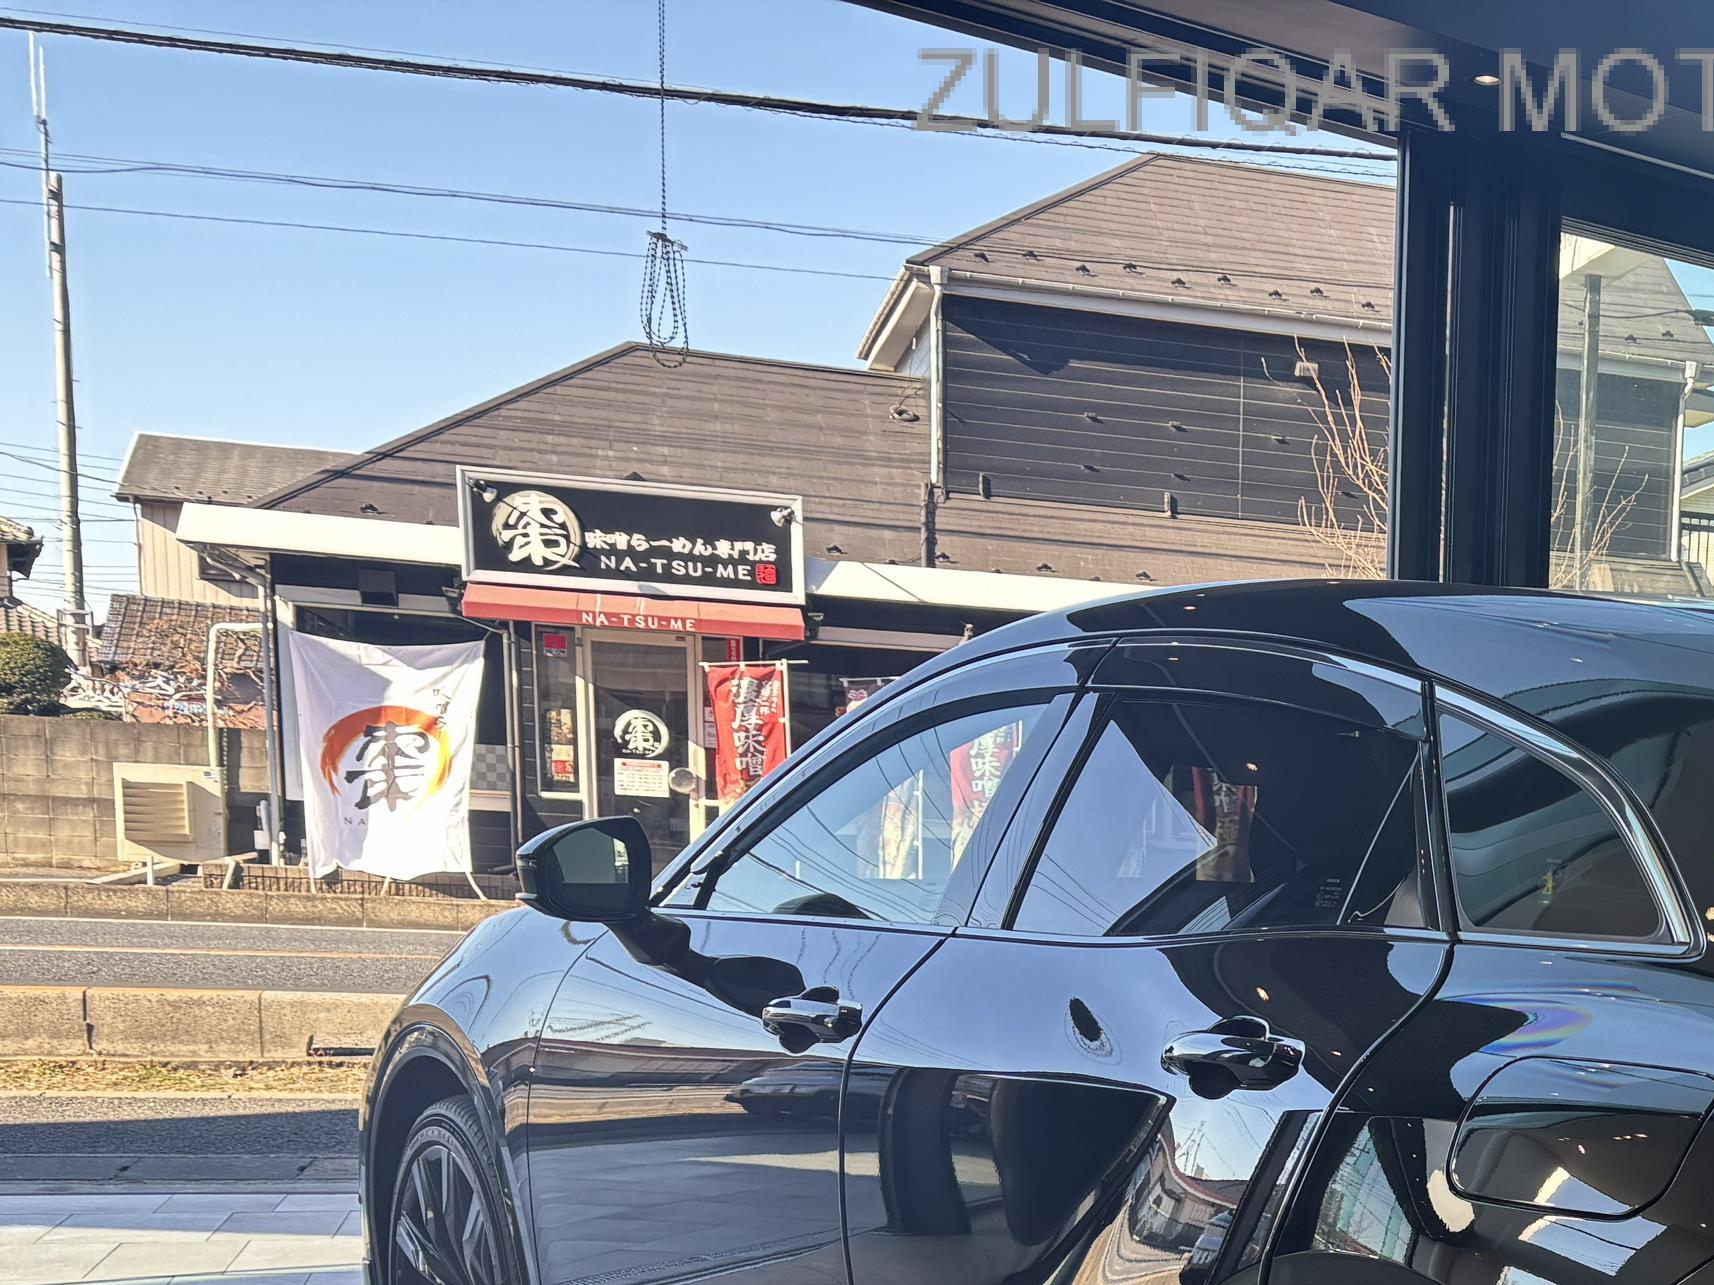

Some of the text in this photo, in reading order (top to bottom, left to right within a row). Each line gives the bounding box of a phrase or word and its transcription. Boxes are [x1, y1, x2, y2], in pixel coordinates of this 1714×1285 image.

[585, 527, 777, 563] 味噌らーめん専門店
[600, 554, 752, 582] NA-TSU-ME
[581, 610, 697, 632] NA-TSU-ME
